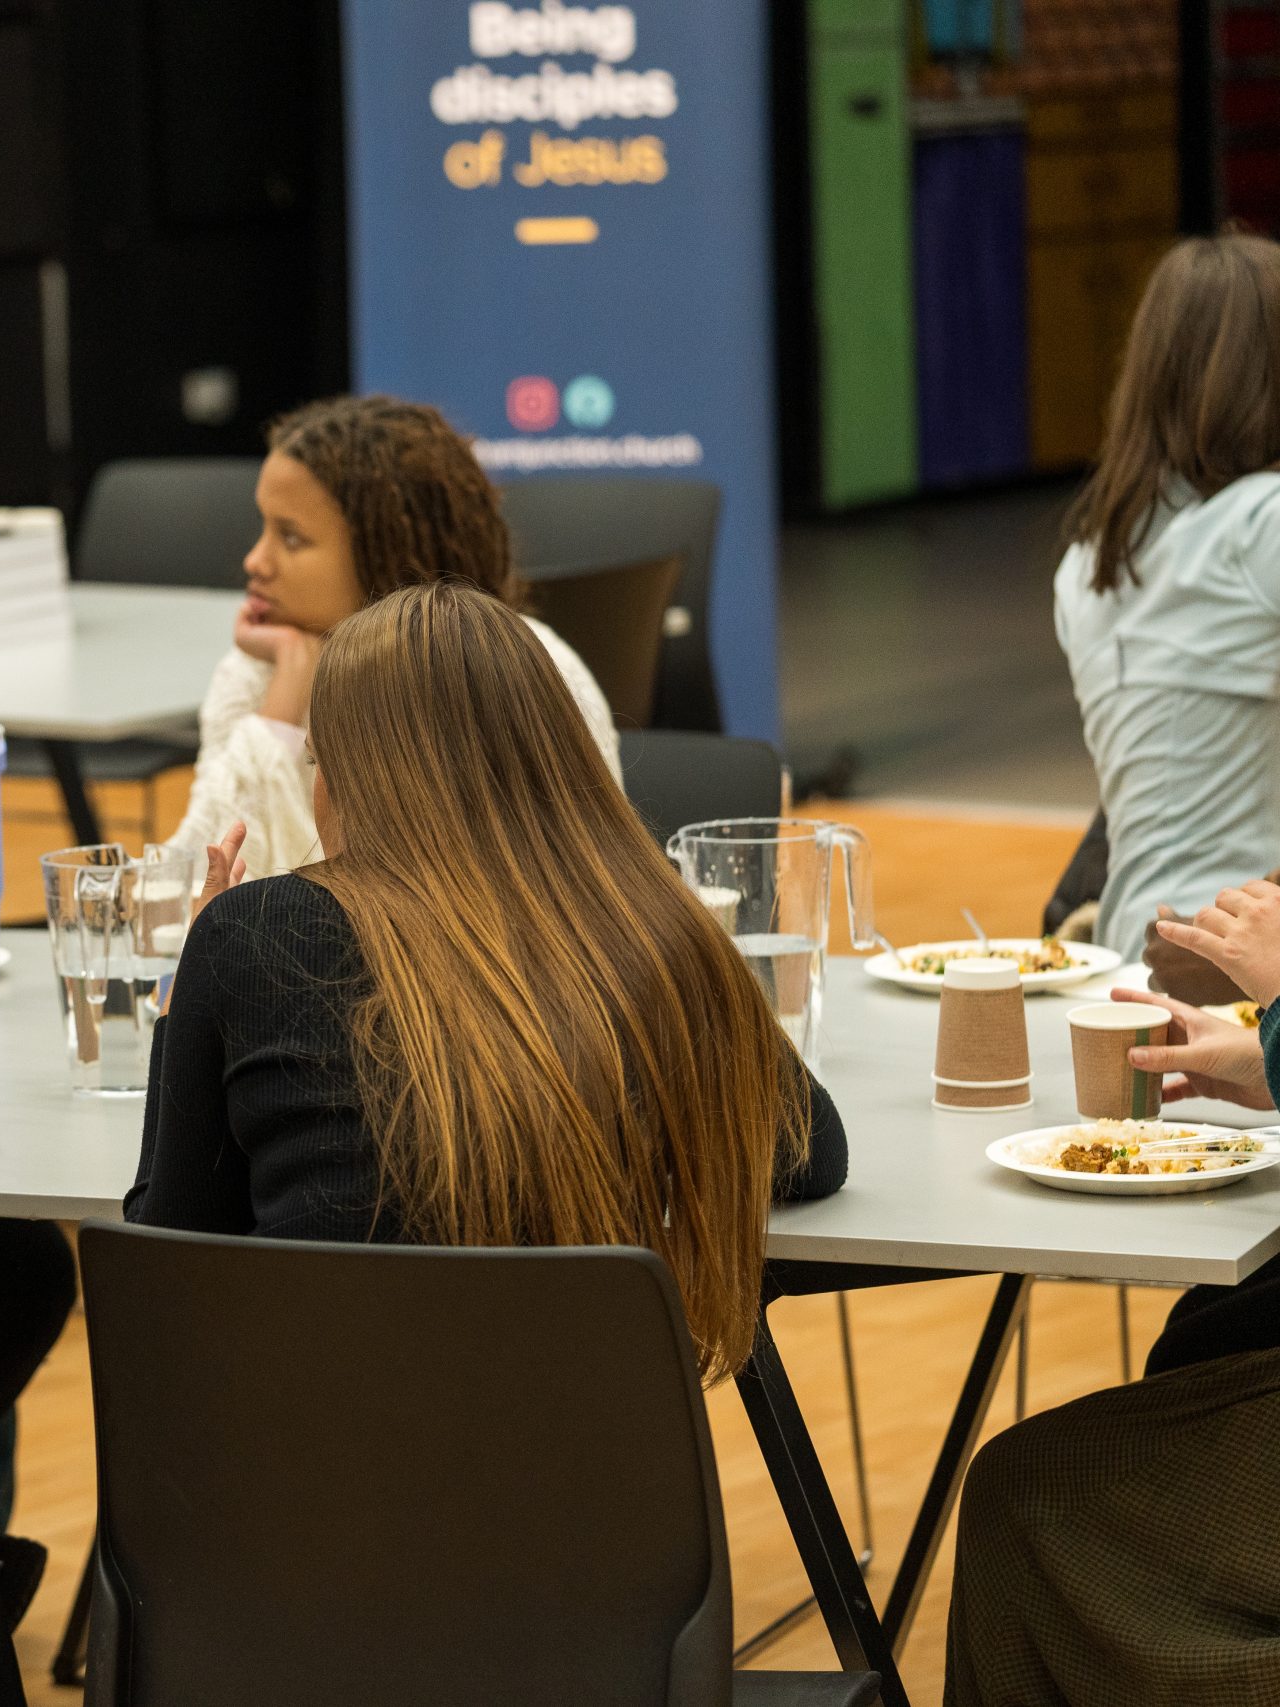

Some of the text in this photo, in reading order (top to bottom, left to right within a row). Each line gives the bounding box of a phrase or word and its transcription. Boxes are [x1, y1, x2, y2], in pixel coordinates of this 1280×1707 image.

[470, 0, 636, 62] Being
[430, 60, 677, 129] disciples
[443, 128, 667, 189] of Jesus
